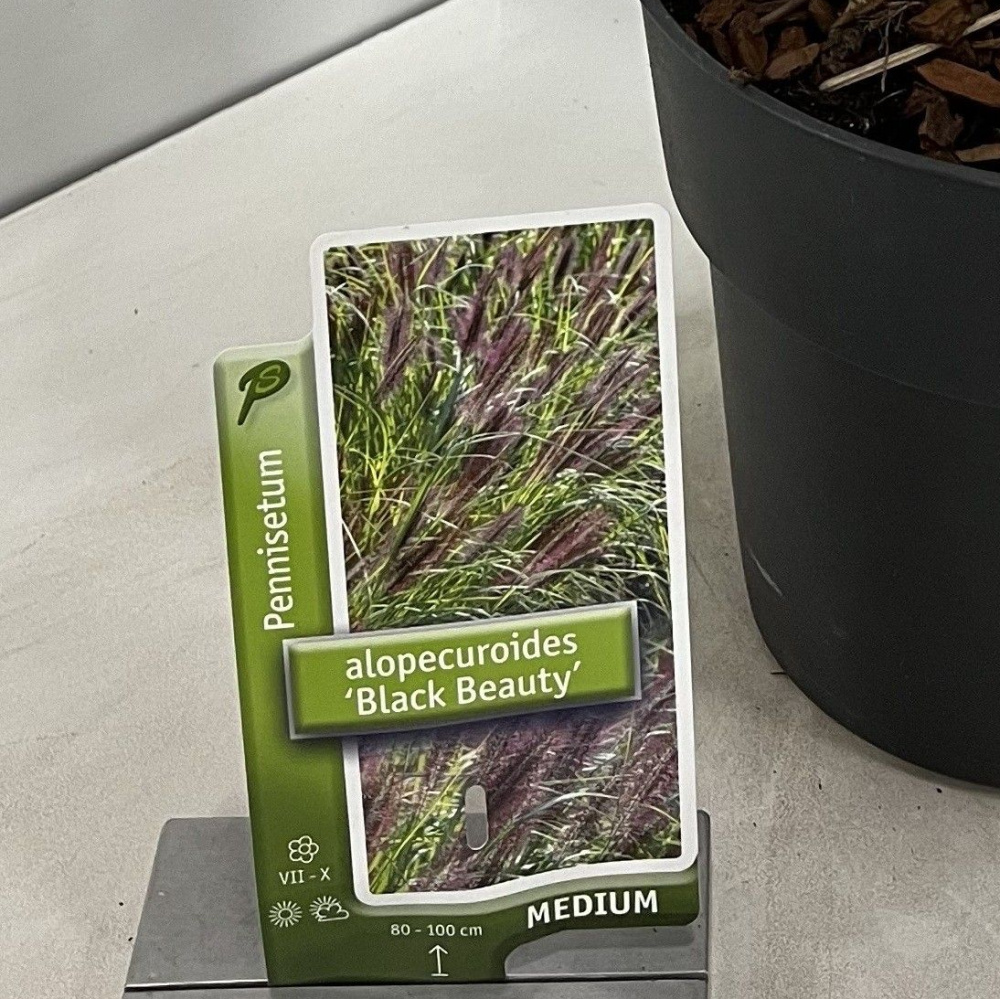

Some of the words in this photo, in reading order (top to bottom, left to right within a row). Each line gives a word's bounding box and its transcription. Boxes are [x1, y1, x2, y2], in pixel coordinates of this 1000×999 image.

[257, 448, 296, 632] Pennisetum
[345, 629, 578, 682] alopecuroides
[345, 684, 446, 717] ‘Black
[456, 661, 582, 705] Beauty’
[278, 869, 304, 885] VII
[390, 924, 409, 938] 80
[427, 923, 455, 937] 100
[461, 925, 483, 937] cm
[526, 889, 658, 927] MEDIUM
